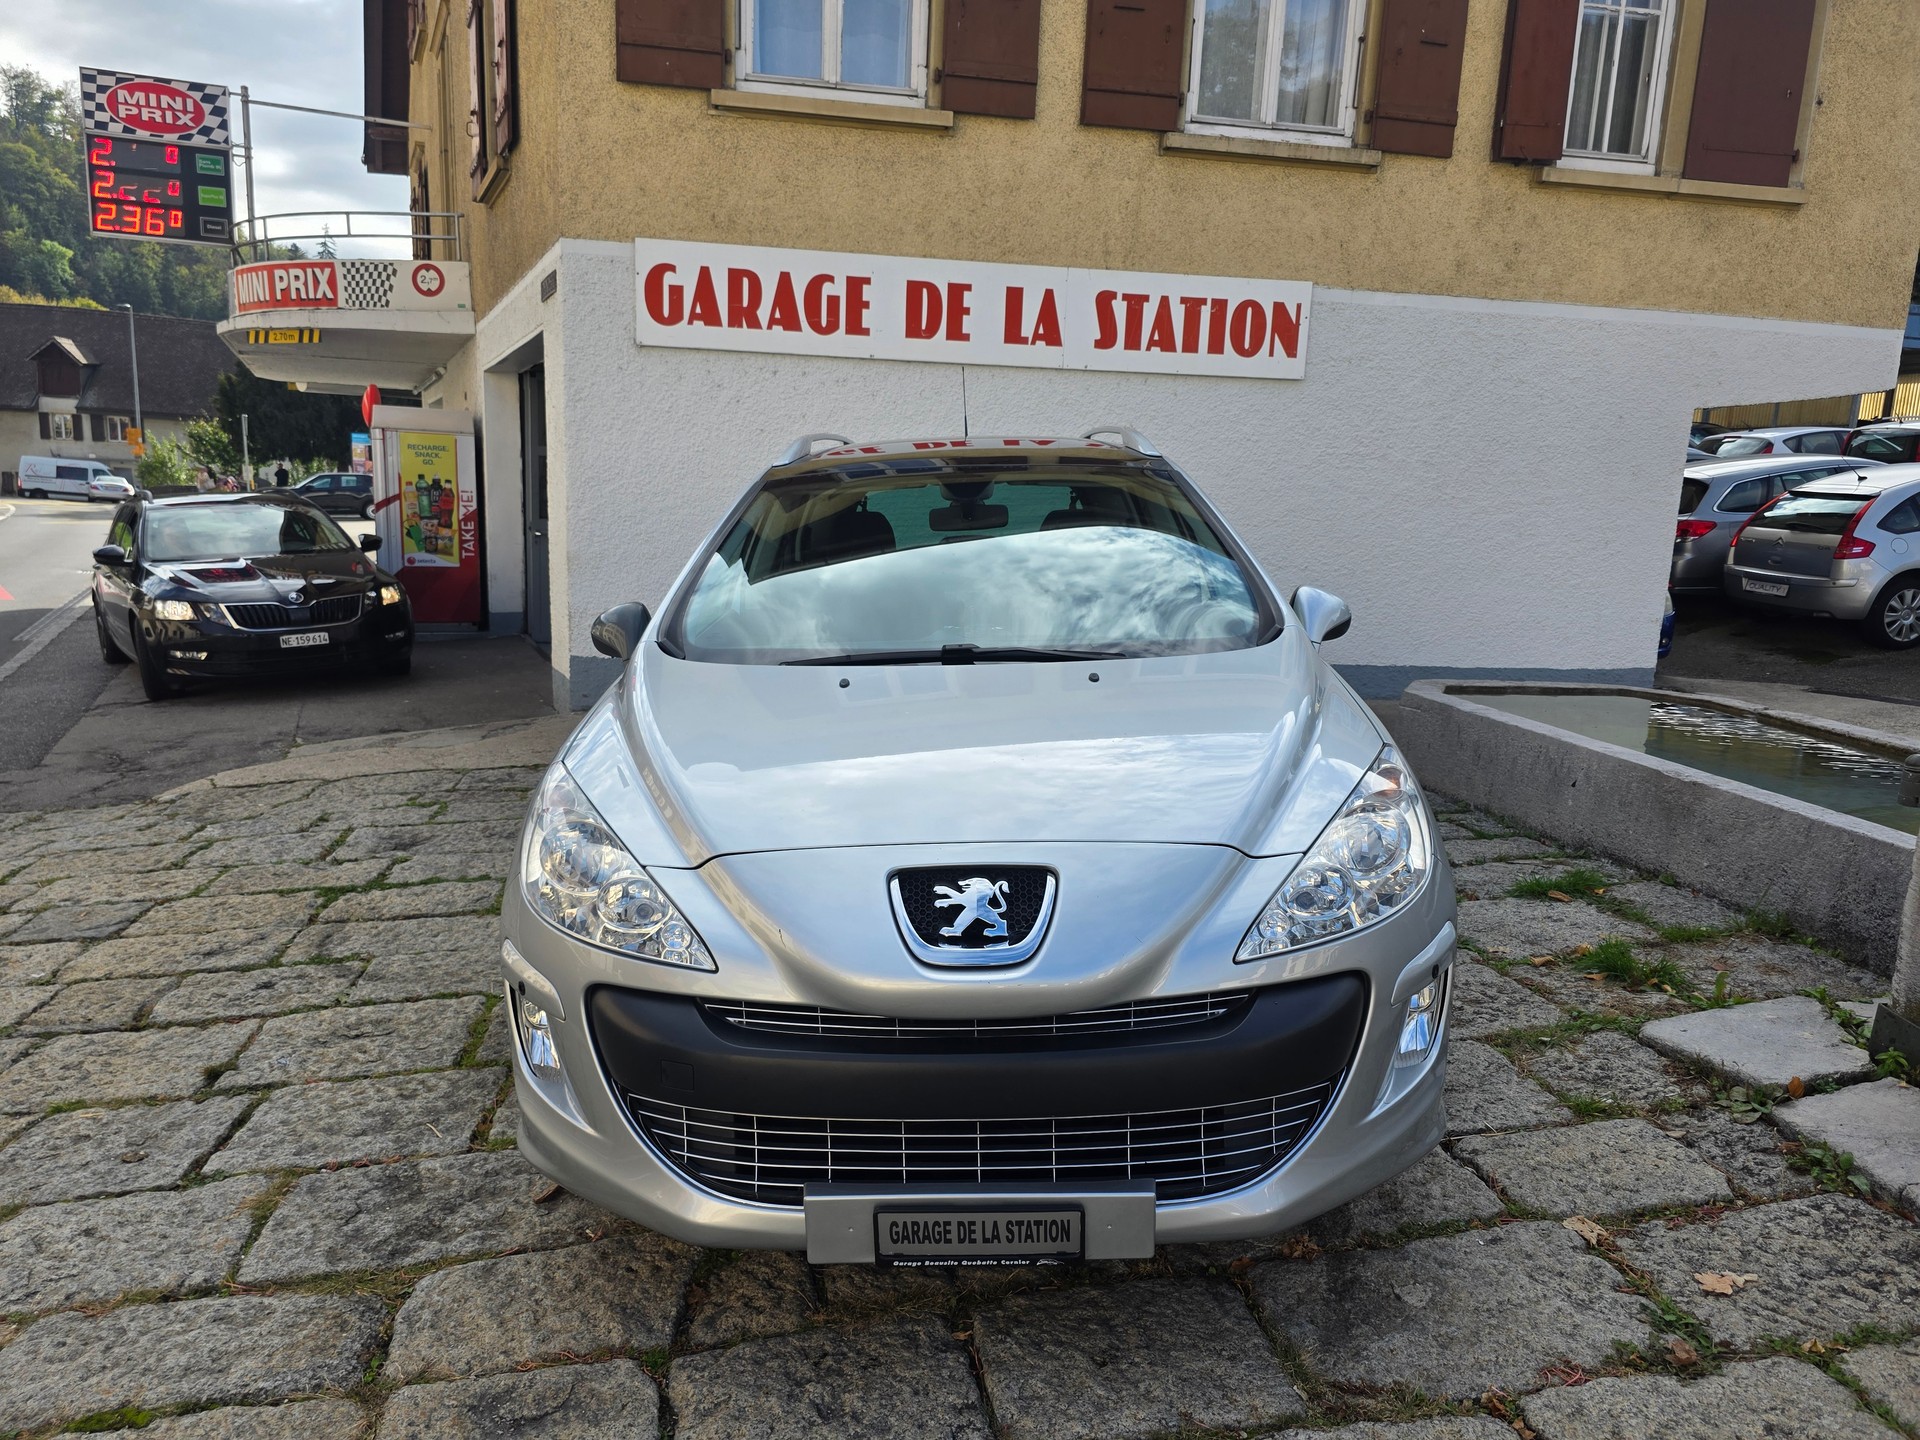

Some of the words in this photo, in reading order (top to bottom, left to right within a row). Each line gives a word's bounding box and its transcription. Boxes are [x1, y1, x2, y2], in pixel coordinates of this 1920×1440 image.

[117, 89, 195, 112] MINI
[117, 104, 196, 127] PRIX
[237, 270, 270, 305] MINI
[273, 267, 335, 301] PRIX
[644, 262, 872, 336] GARAGE
[905, 279, 973, 342] DE
[1003, 286, 1063, 348] LA
[1094, 289, 1302, 359] STATION
[460, 490, 474, 517] ME!
[461, 521, 475, 559] TAKE
[889, 1221, 952, 1245] GARAGE
[957, 1221, 977, 1244] DE
[982, 1220, 1001, 1244] LA
[1005, 1219, 1071, 1244] STATION
